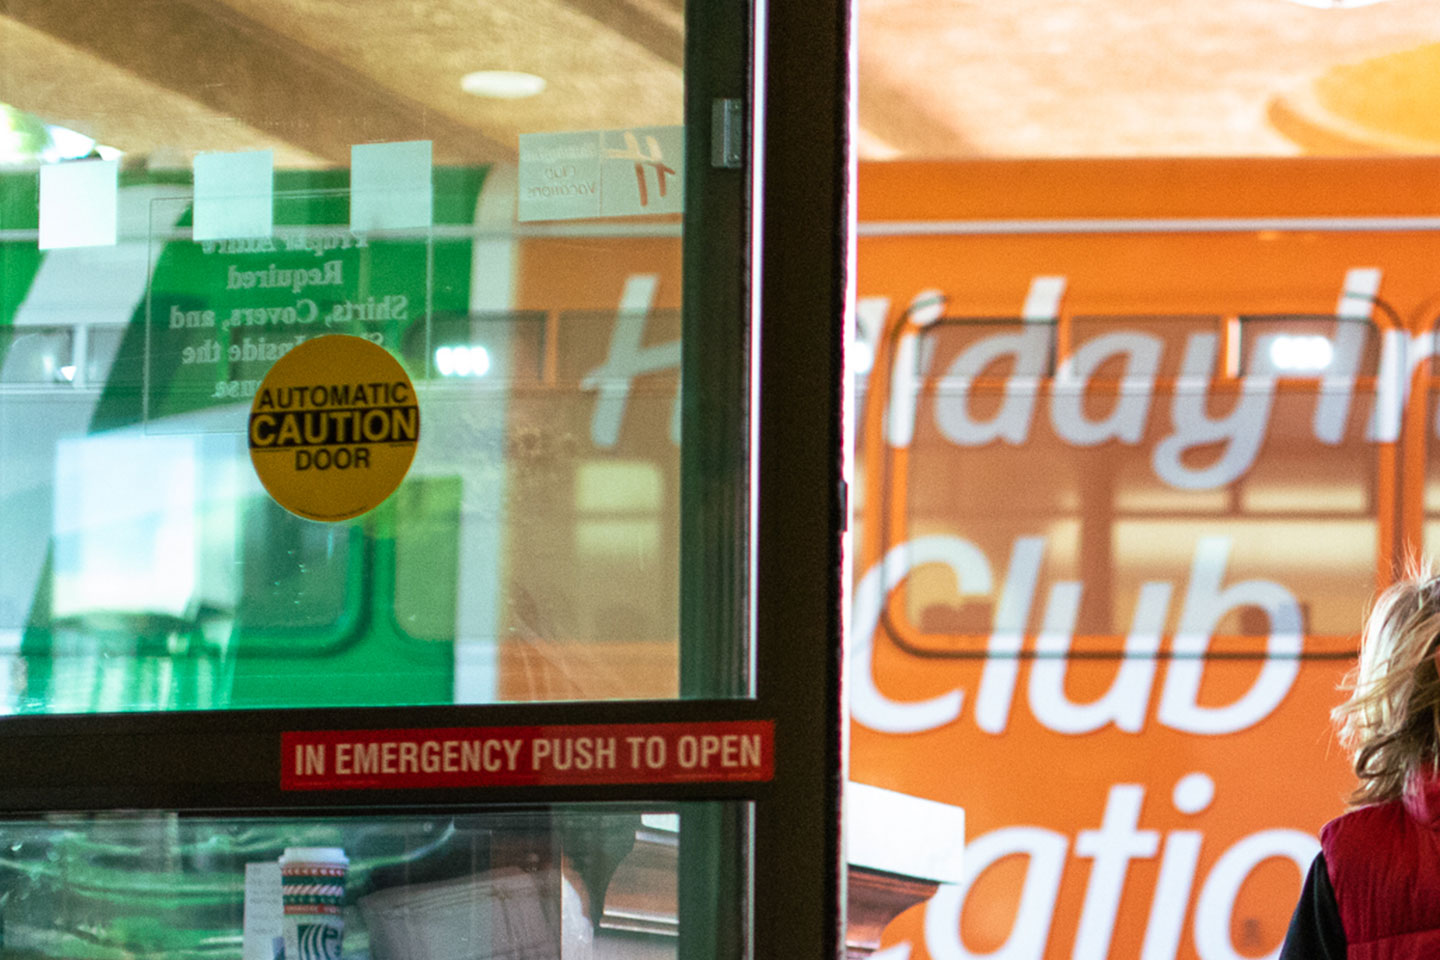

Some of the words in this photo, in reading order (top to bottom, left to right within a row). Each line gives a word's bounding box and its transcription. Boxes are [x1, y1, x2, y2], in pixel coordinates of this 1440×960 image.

[258, 381, 410, 409] AUTOMATIC
[250, 408, 418, 446] CAUTION
[295, 447, 371, 471] DOOR
[848, 533, 1304, 735] Club
[295, 744, 326, 776] IN
[335, 738, 524, 775] EMERGENCY
[531, 737, 616, 771] PUSH
[625, 735, 668, 769] TO
[677, 734, 762, 769] OPEN
